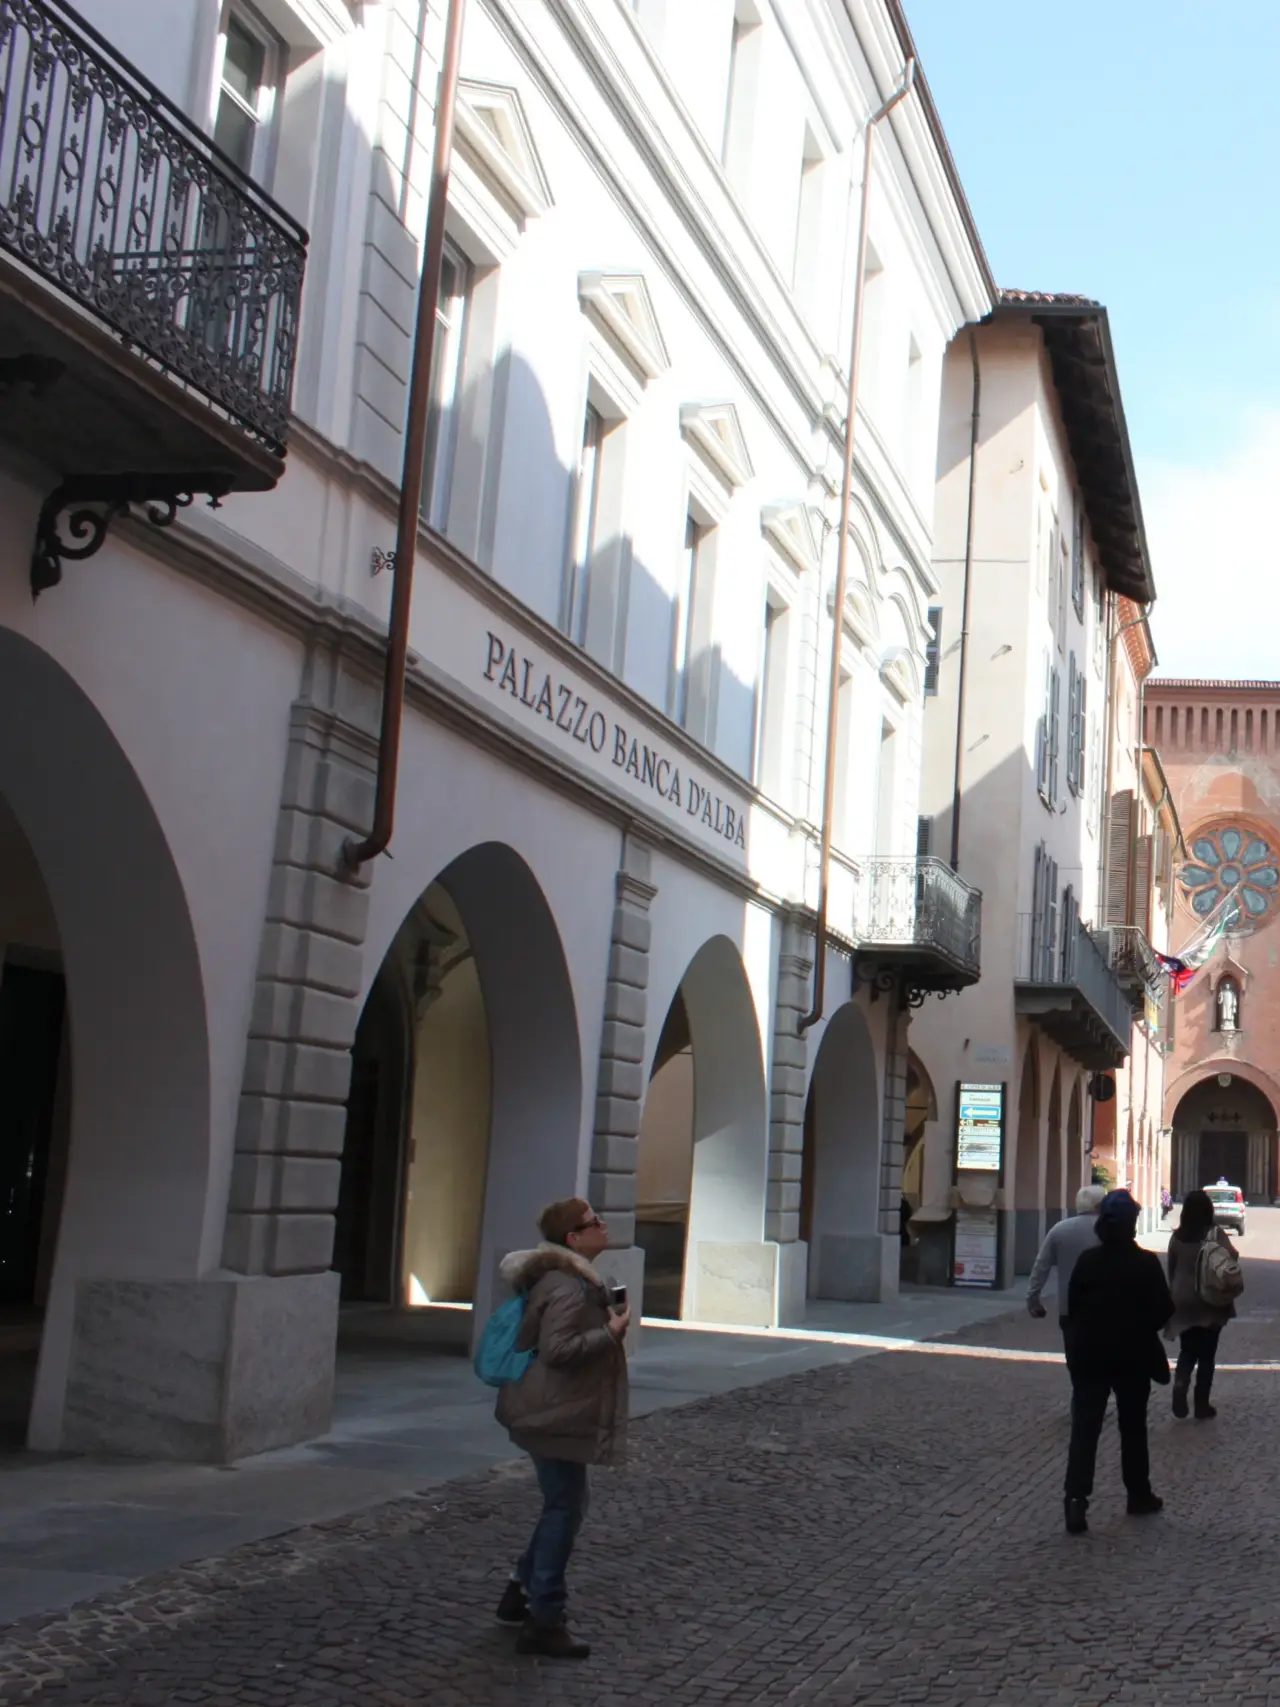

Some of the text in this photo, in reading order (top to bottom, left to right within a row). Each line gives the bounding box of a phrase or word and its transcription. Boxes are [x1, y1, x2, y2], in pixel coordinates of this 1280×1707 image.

[483, 631, 746, 850] PALAZZO BANCA D'ALBA
